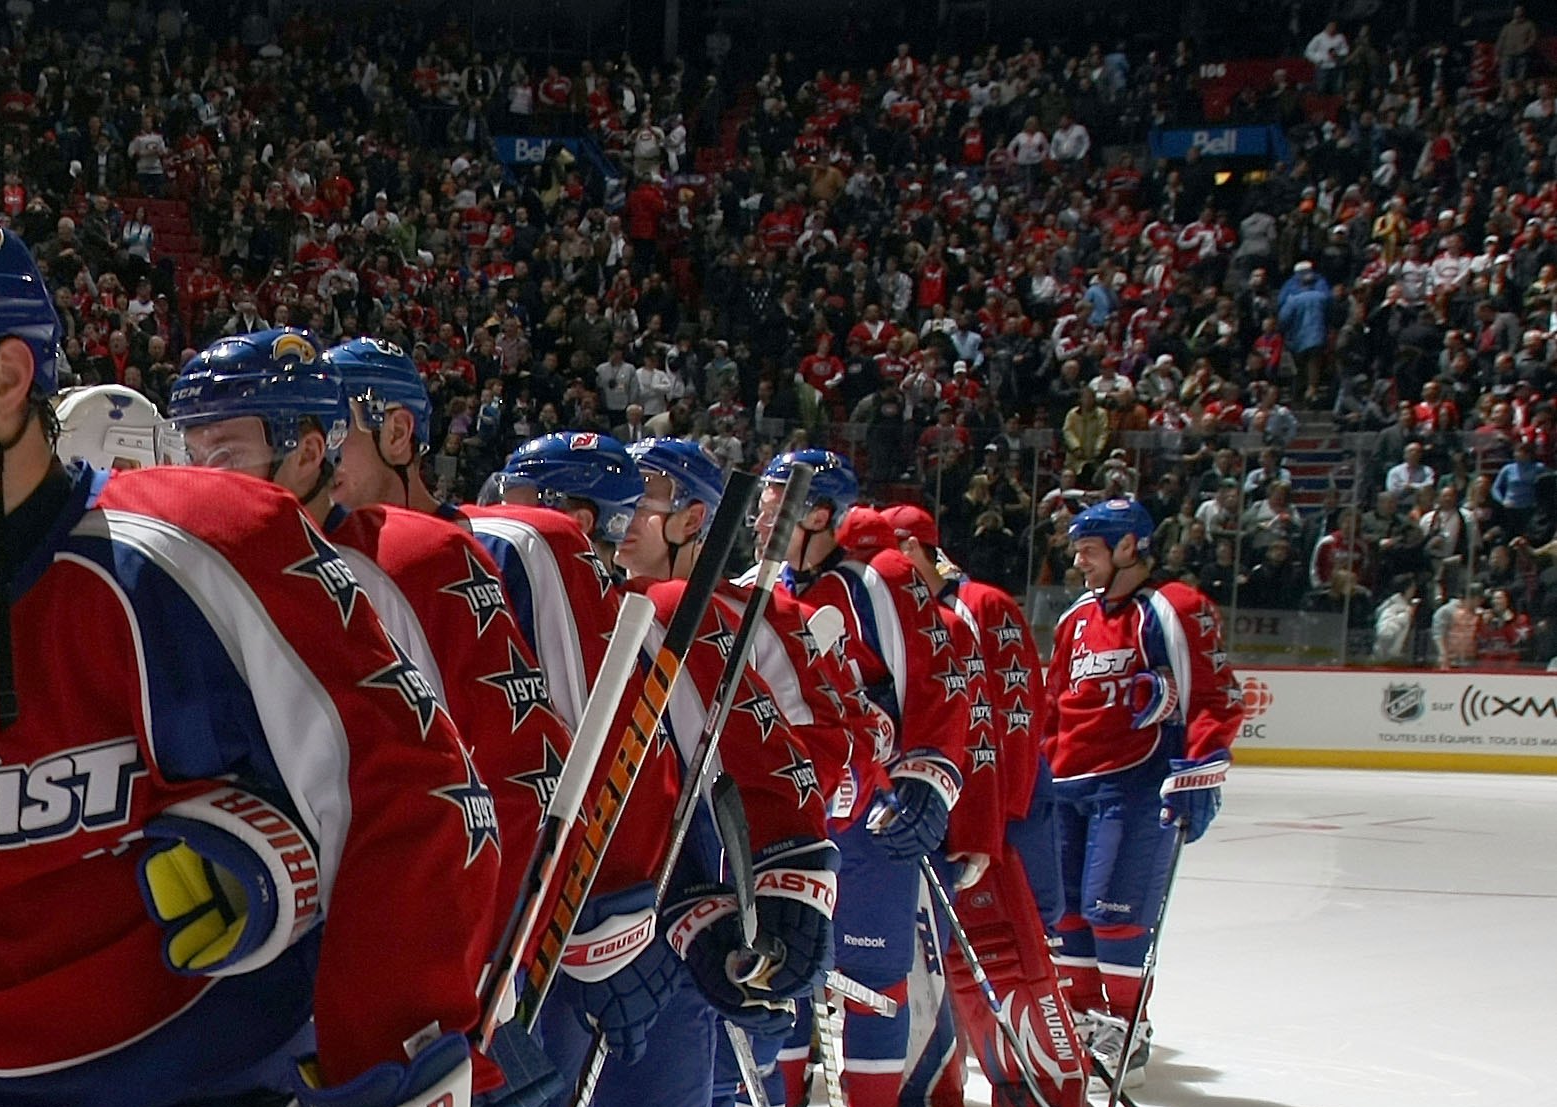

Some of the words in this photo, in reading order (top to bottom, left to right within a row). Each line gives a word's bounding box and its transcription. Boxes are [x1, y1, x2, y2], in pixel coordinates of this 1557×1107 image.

[1192, 131, 1238, 153] Bell
[316, 560, 355, 595] 196
[1073, 620, 1088, 640] C
[1071, 649, 1136, 679] EAST
[396, 669, 437, 706] 197
[506, 678, 550, 704] 1975
[1430, 701, 1454, 713] sur
[1235, 724, 1266, 739] BC
[1379, 732, 1417, 743] TOUTES
[1419, 733, 1437, 743] LES
[1489, 735, 1518, 745] TOUS
[1520, 735, 1539, 746] LES
[898, 762, 959, 801] ASTON
[843, 934, 886, 949] Reebok
[1038, 994, 1074, 1062] VAUGHN
